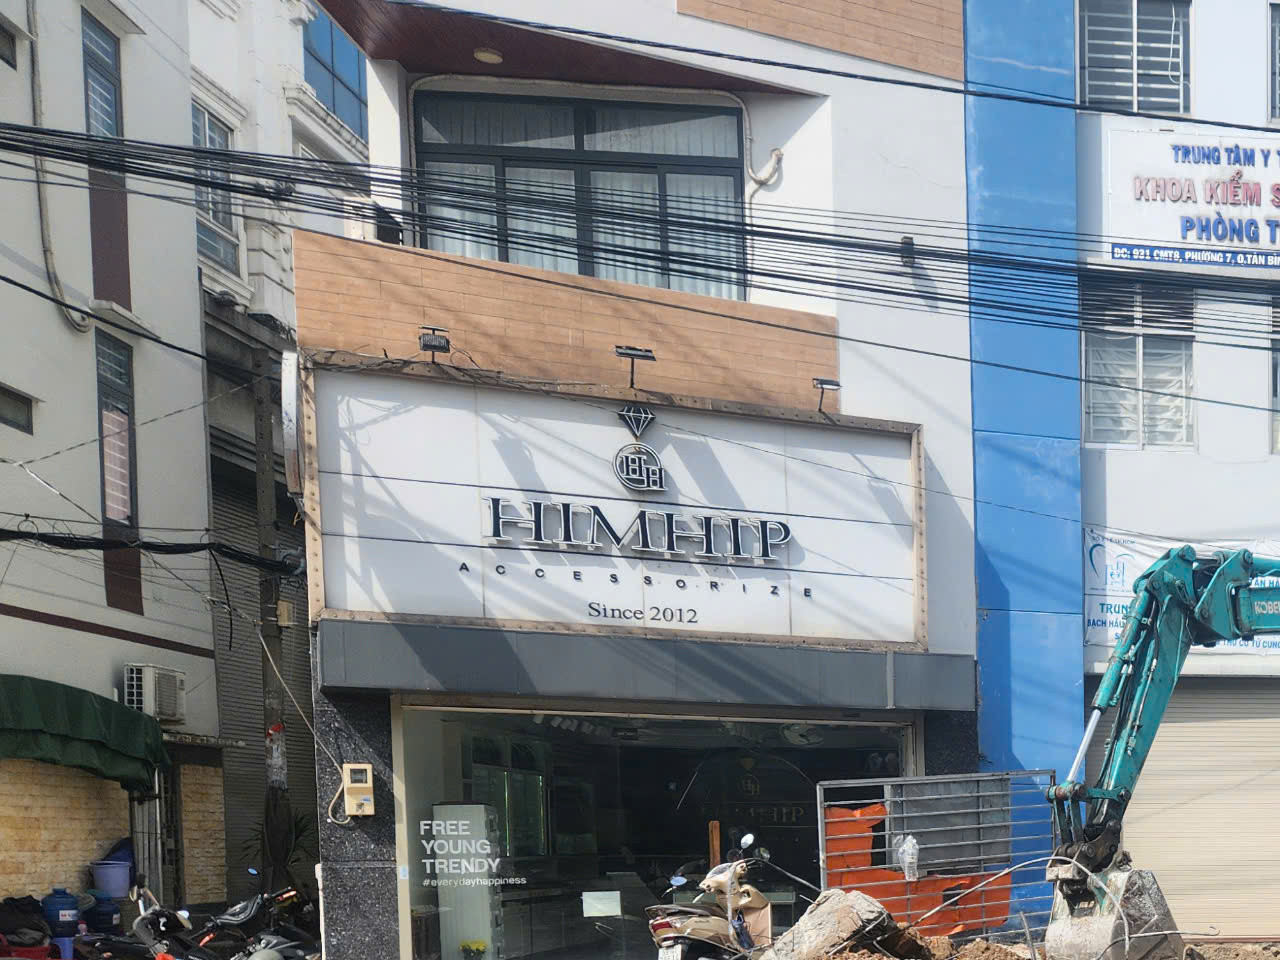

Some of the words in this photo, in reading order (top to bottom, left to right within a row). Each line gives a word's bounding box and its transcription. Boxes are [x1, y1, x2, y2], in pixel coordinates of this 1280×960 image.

[1171, 144, 1220, 165] TRUNG
[1224, 144, 1255, 167] TÂM
[1260, 149, 1271, 168] Y
[1133, 176, 1197, 203] KHOA
[1204, 169, 1261, 207] KIỂM
[1180, 211, 1259, 241] PHÒNG
[482, 496, 792, 562] HIMHIP
[458, 561, 813, 598] ACCESSORIZE
[587, 601, 645, 622] Since
[649, 605, 699, 625] 2012
[419, 820, 471, 836] FREE
[420, 839, 492, 855] YOUNG
[421, 857, 501, 874] TRENDY
[422, 877, 527, 888] #everydayhappiness
